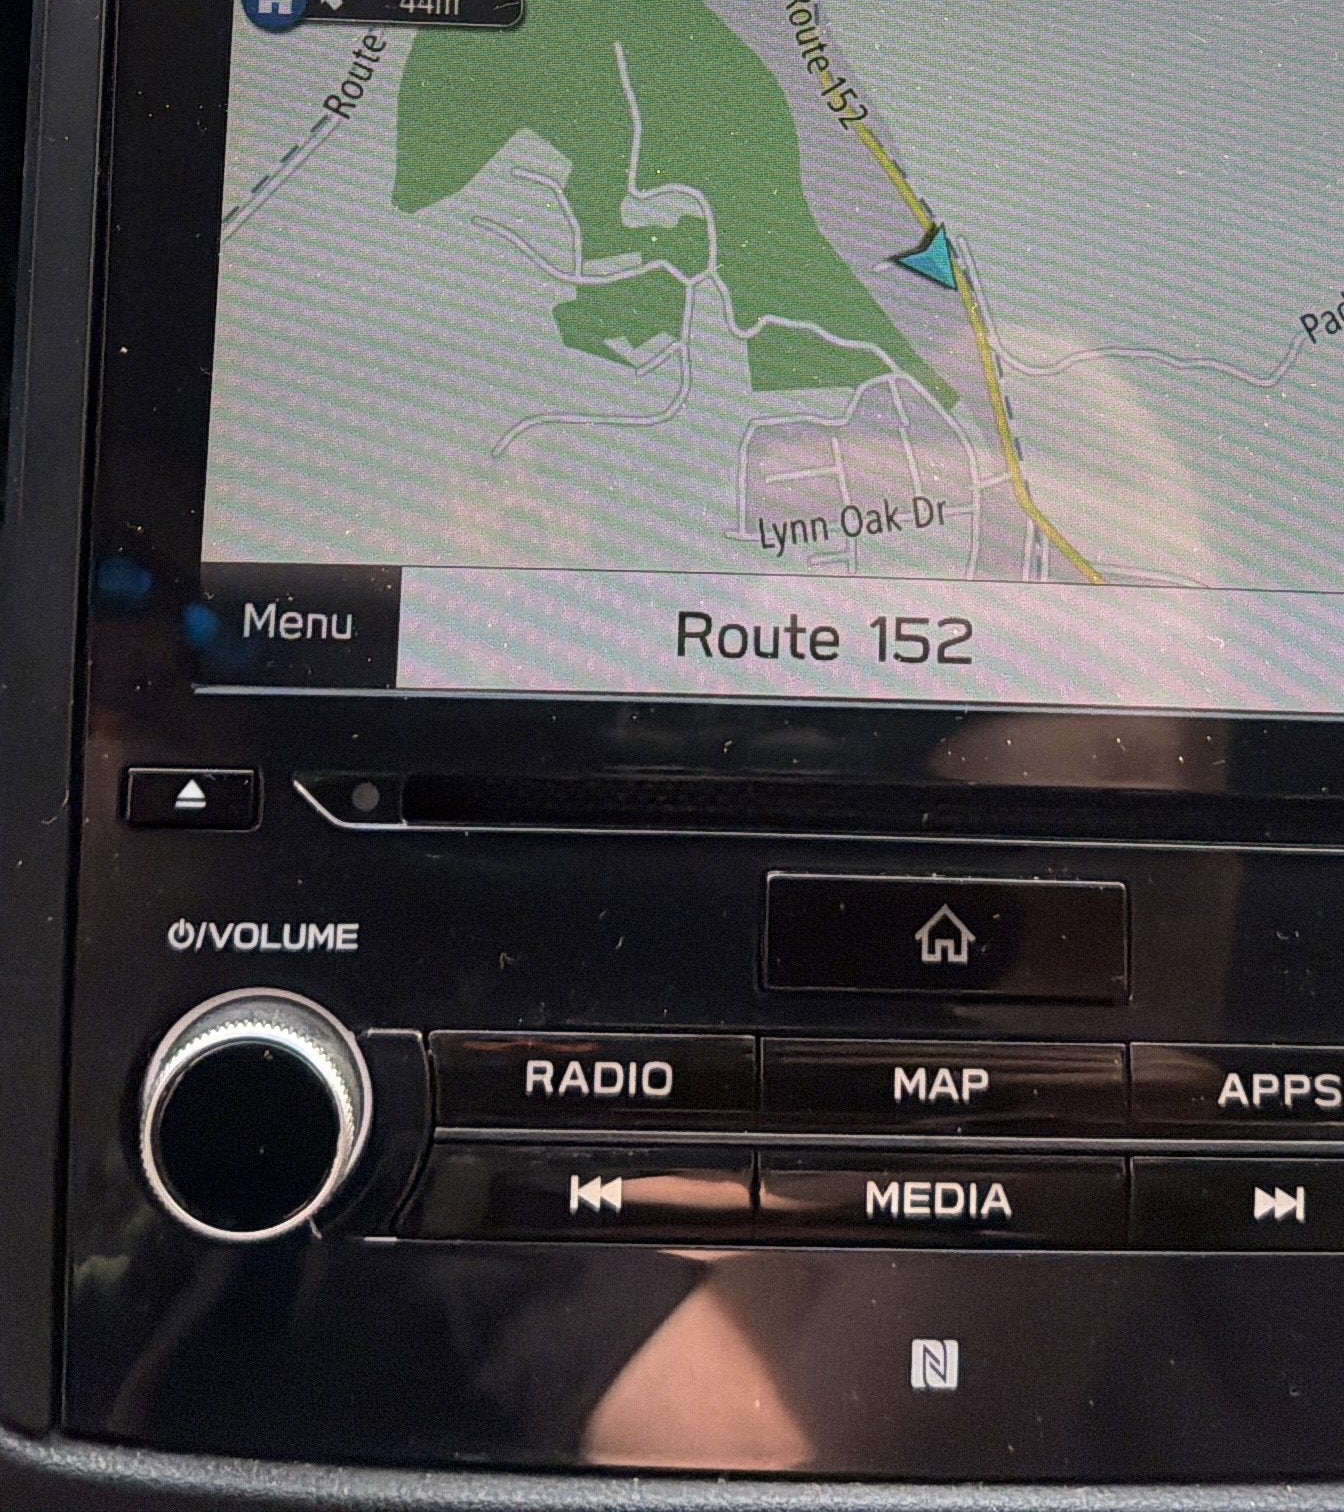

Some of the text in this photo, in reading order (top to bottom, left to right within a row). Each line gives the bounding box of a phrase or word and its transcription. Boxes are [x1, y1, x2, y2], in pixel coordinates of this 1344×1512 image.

[322, 34, 387, 120] Route
[820, 76, 869, 131] 152
[758, 495, 947, 558] Lynn Oak Dr
[242, 601, 353, 640] Menu
[676, 610, 974, 665] Route 152
[525, 1059, 674, 1098] RADIO
[893, 1067, 990, 1102] MAP
[1217, 1072, 1343, 1109] APPS
[865, 1180, 1014, 1220] MEDIA
